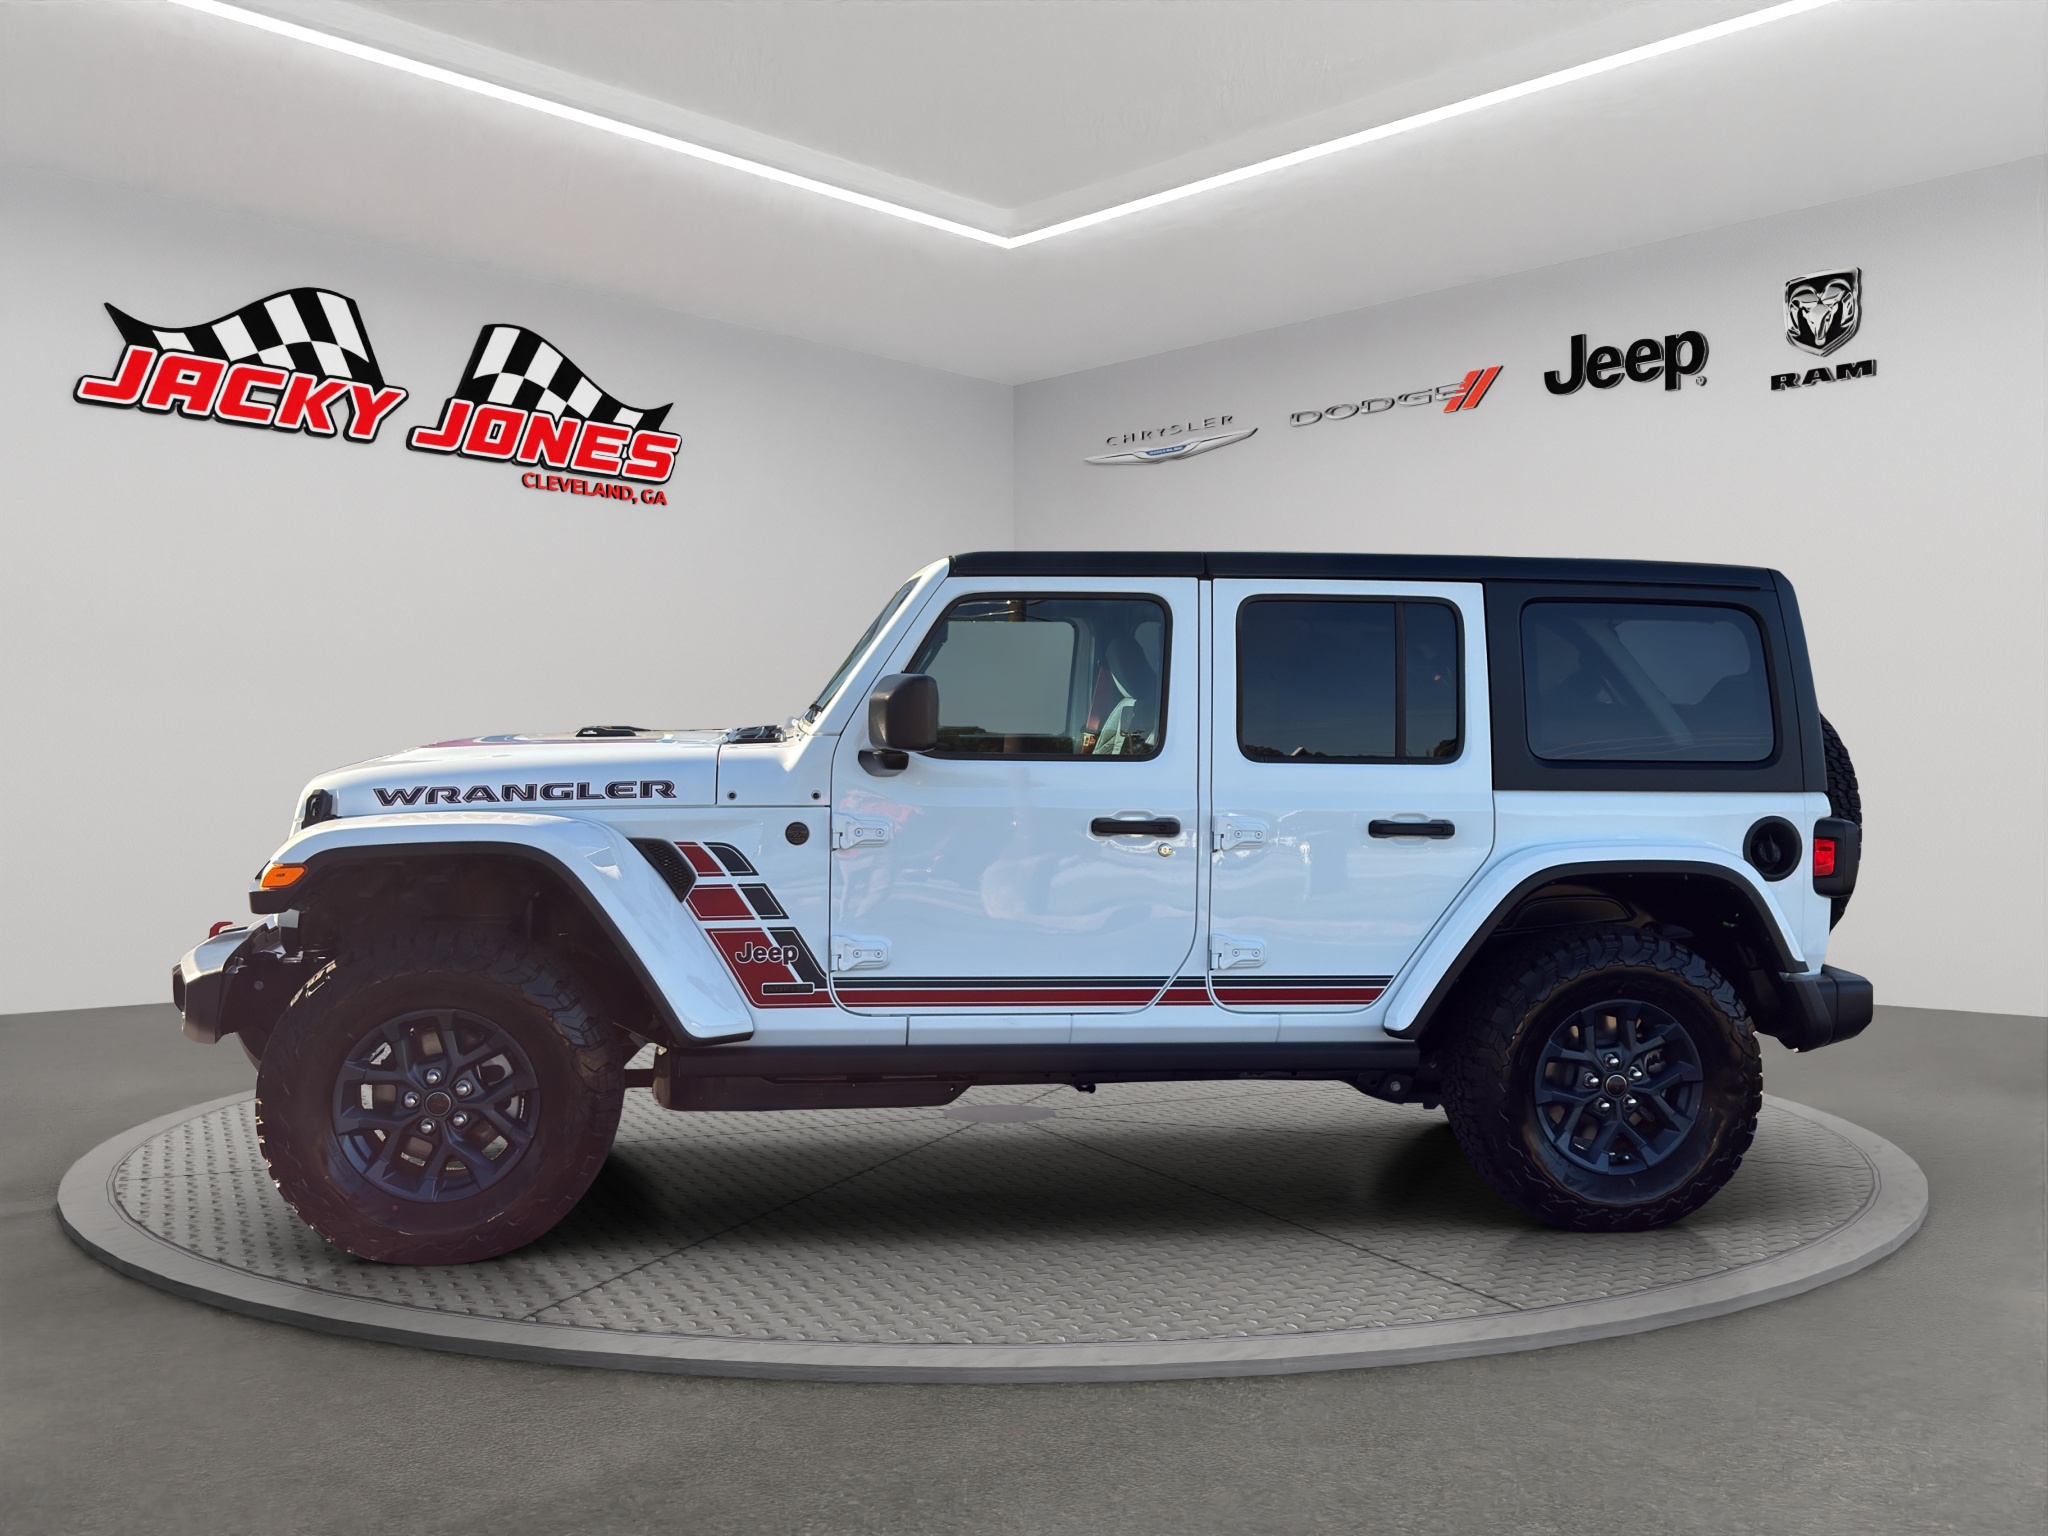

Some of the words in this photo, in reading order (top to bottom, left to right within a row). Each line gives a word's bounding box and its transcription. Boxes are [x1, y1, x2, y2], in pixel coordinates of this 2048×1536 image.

[1771, 359, 1877, 391] RAM
[74, 344, 409, 443] JACKY
[406, 398, 683, 485] JONES
[1290, 381, 1468, 428] DODGE
[1106, 415, 1233, 446] CHRYSLER
[522, 472, 639, 504] CLEVELAND,
[641, 489, 668, 506] GA
[373, 780, 677, 806] WRANGLER
[735, 942, 799, 966] Jeep
